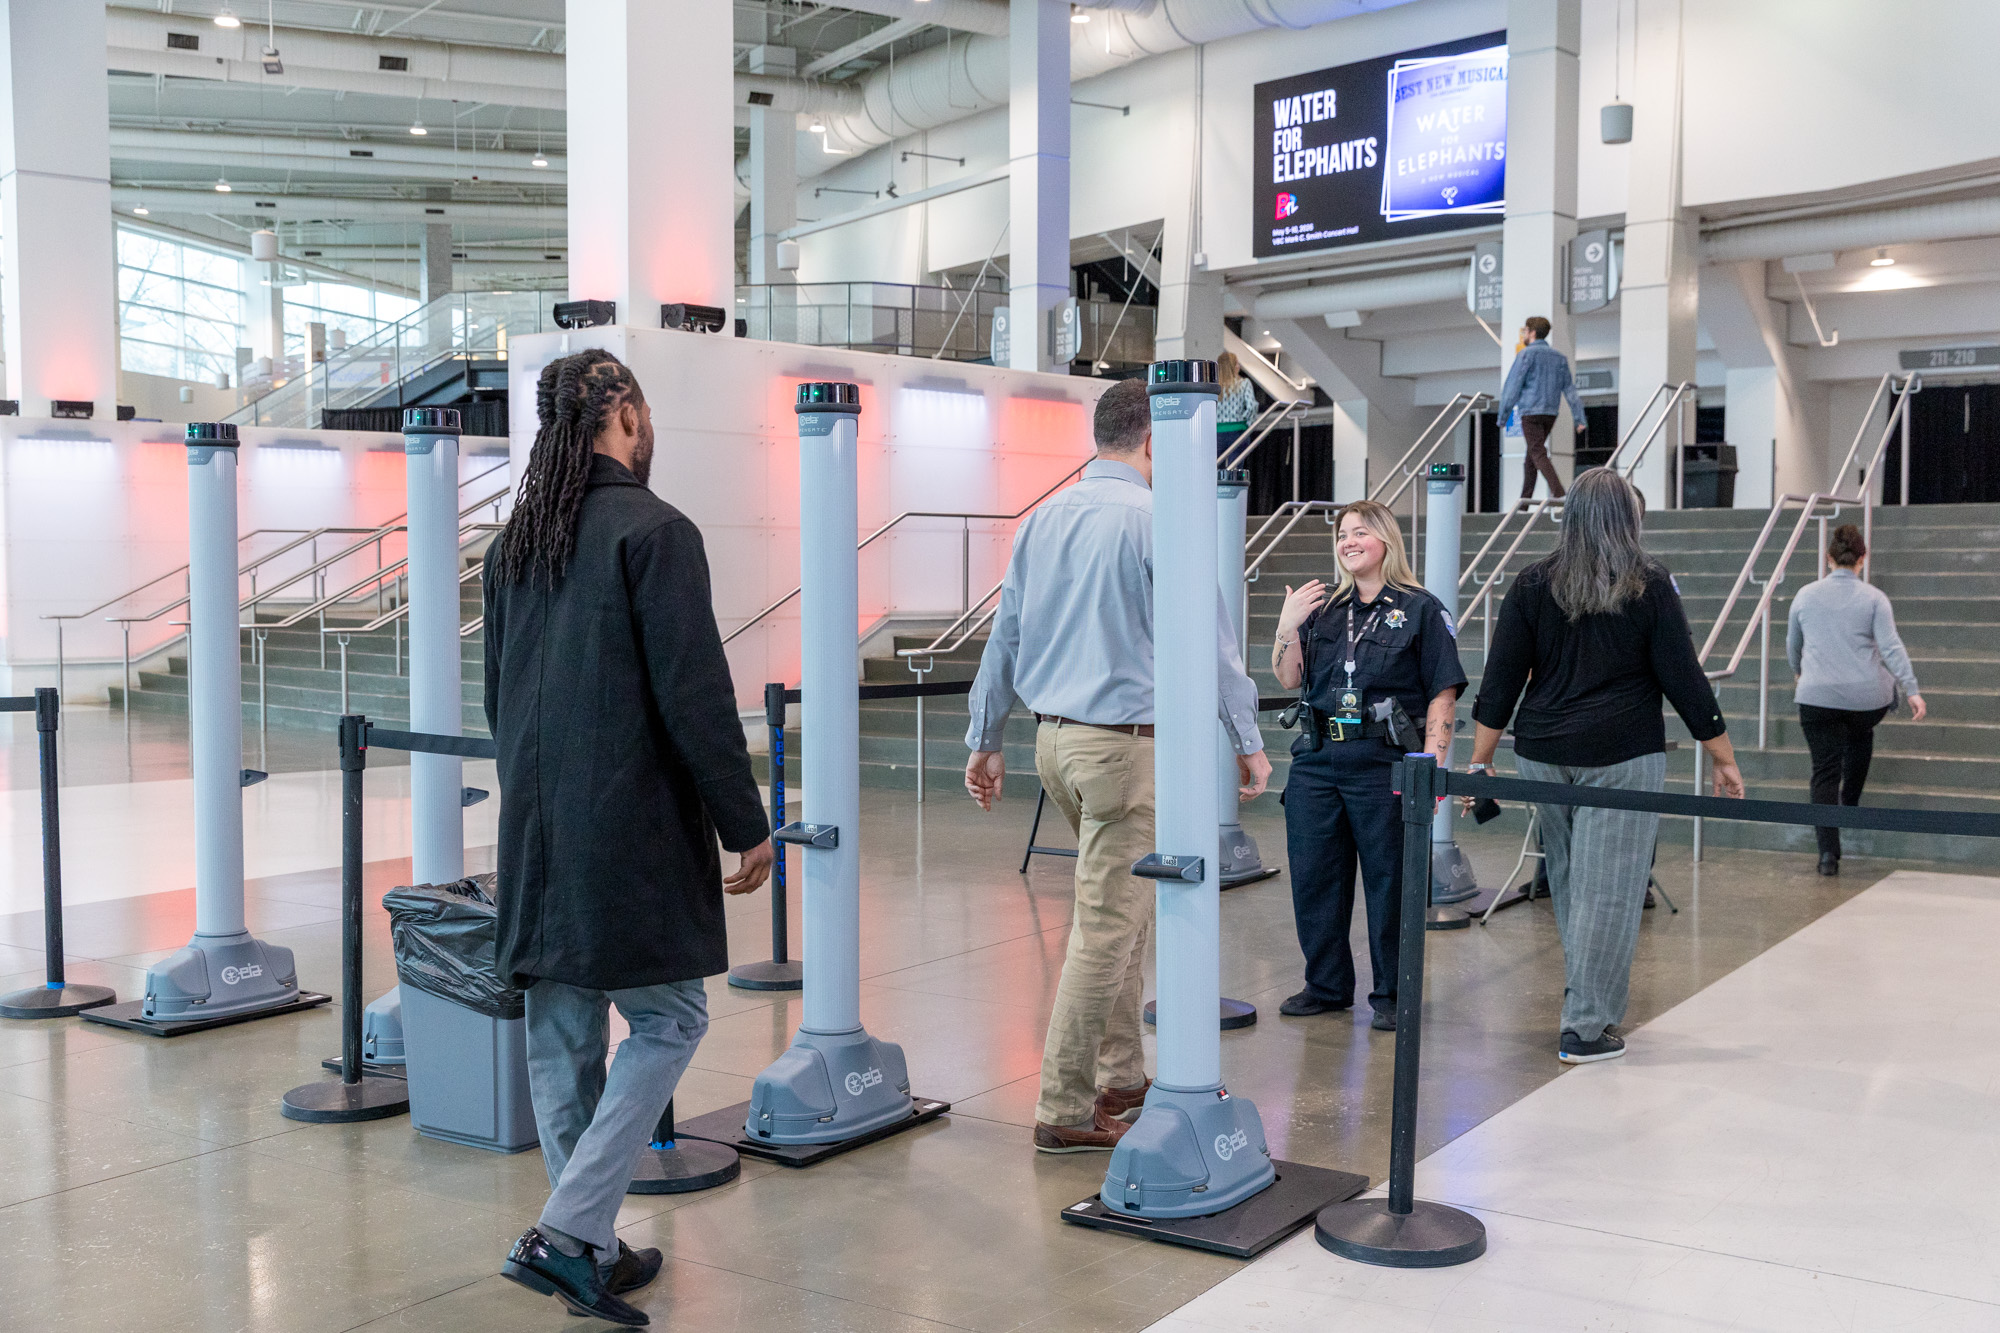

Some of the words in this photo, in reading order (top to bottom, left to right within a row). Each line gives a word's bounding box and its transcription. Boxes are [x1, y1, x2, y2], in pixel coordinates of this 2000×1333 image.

[1395, 81, 1423, 104] BEST
[1426, 73, 1454, 93] NEW
[1273, 88, 1337, 129] WATER
[1416, 104, 1485, 133] WATER
[1273, 126, 1303, 155] FOR
[1441, 135, 1459, 145] FOR
[1273, 136, 1378, 184] ELEPHANTS
[1397, 141, 1505, 176] ELEPHANTS
[1272, 228, 1285, 237] May
[1285, 234, 1299, 244] Mark
[1306, 231, 1323, 241] Smith
[1323, 226, 1346, 238] Concert
[1346, 225, 1359, 235] Hall
[1929, 348, 1977, 367] 211-210
[775, 727, 785, 766] VBC
